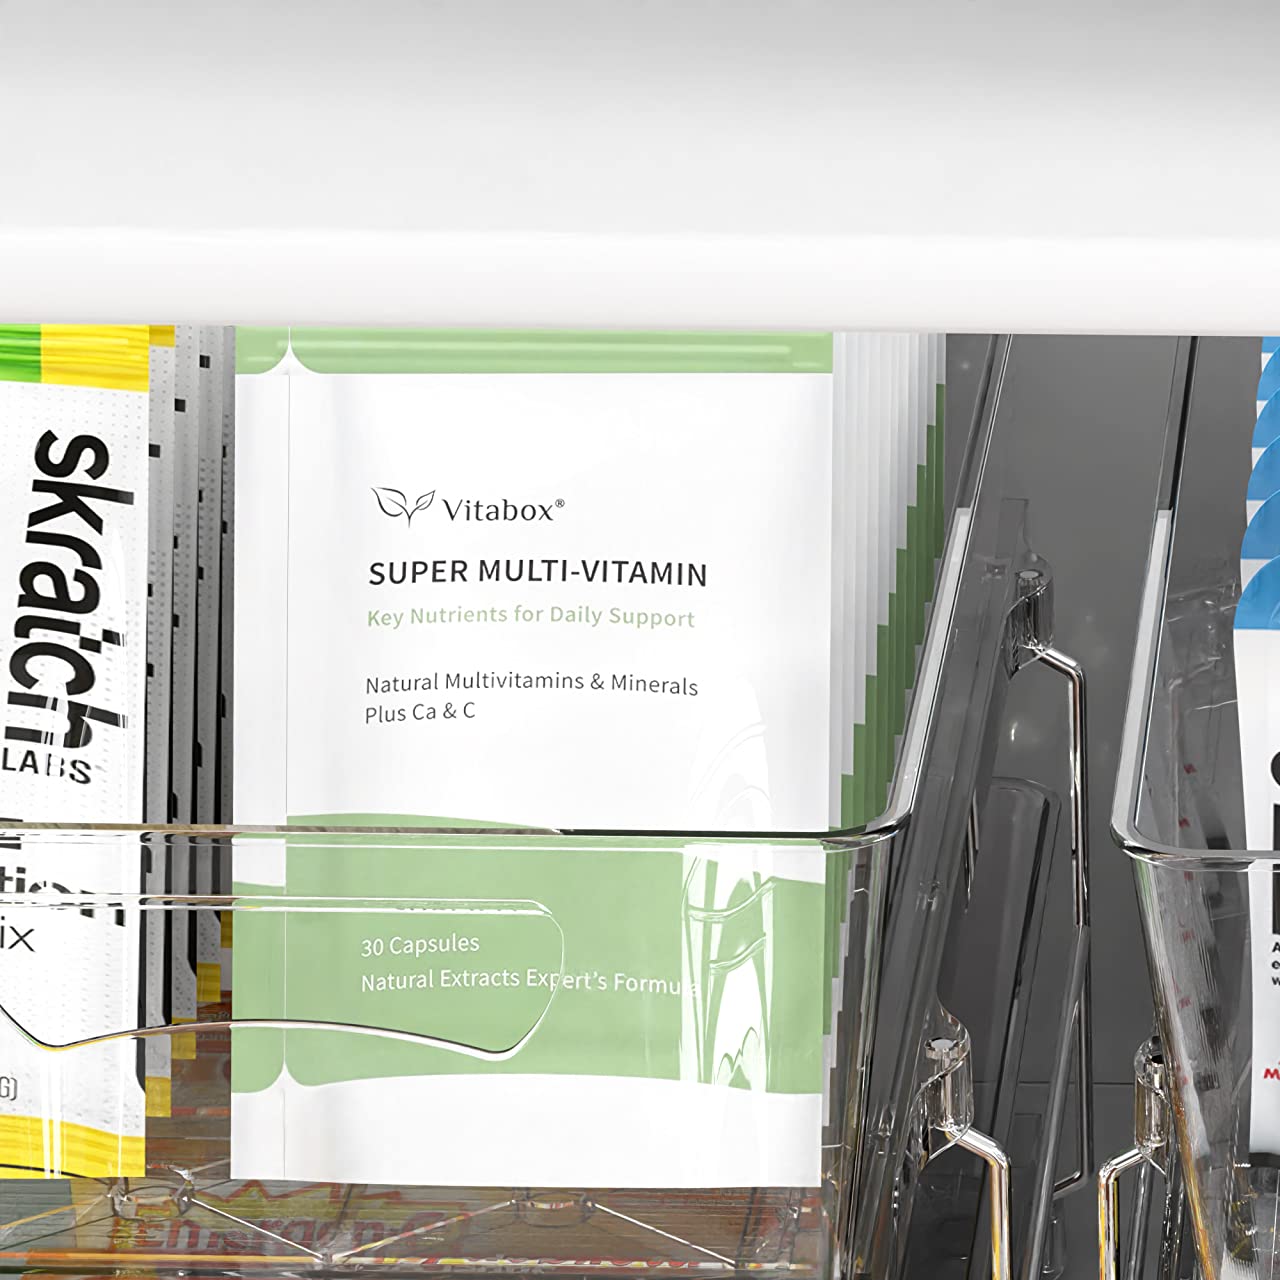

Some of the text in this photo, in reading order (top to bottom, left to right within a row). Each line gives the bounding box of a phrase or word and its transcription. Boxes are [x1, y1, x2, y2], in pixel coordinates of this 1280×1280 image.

[369, 559, 707, 587] SUPER MULTI-VITAMIN
[367, 604, 695, 629] Key Nutrients for Daily Support
[366, 671, 699, 696] Natural Multivitamins & Minerals
[365, 702, 476, 724] Plus Ca & C
[2, 748, 92, 784] LABS
[361, 933, 480, 959] 30 Capsules
[361, 969, 435, 992] Natural
[440, 968, 520, 989] Extracts
[614, 972, 698, 996] Formu
